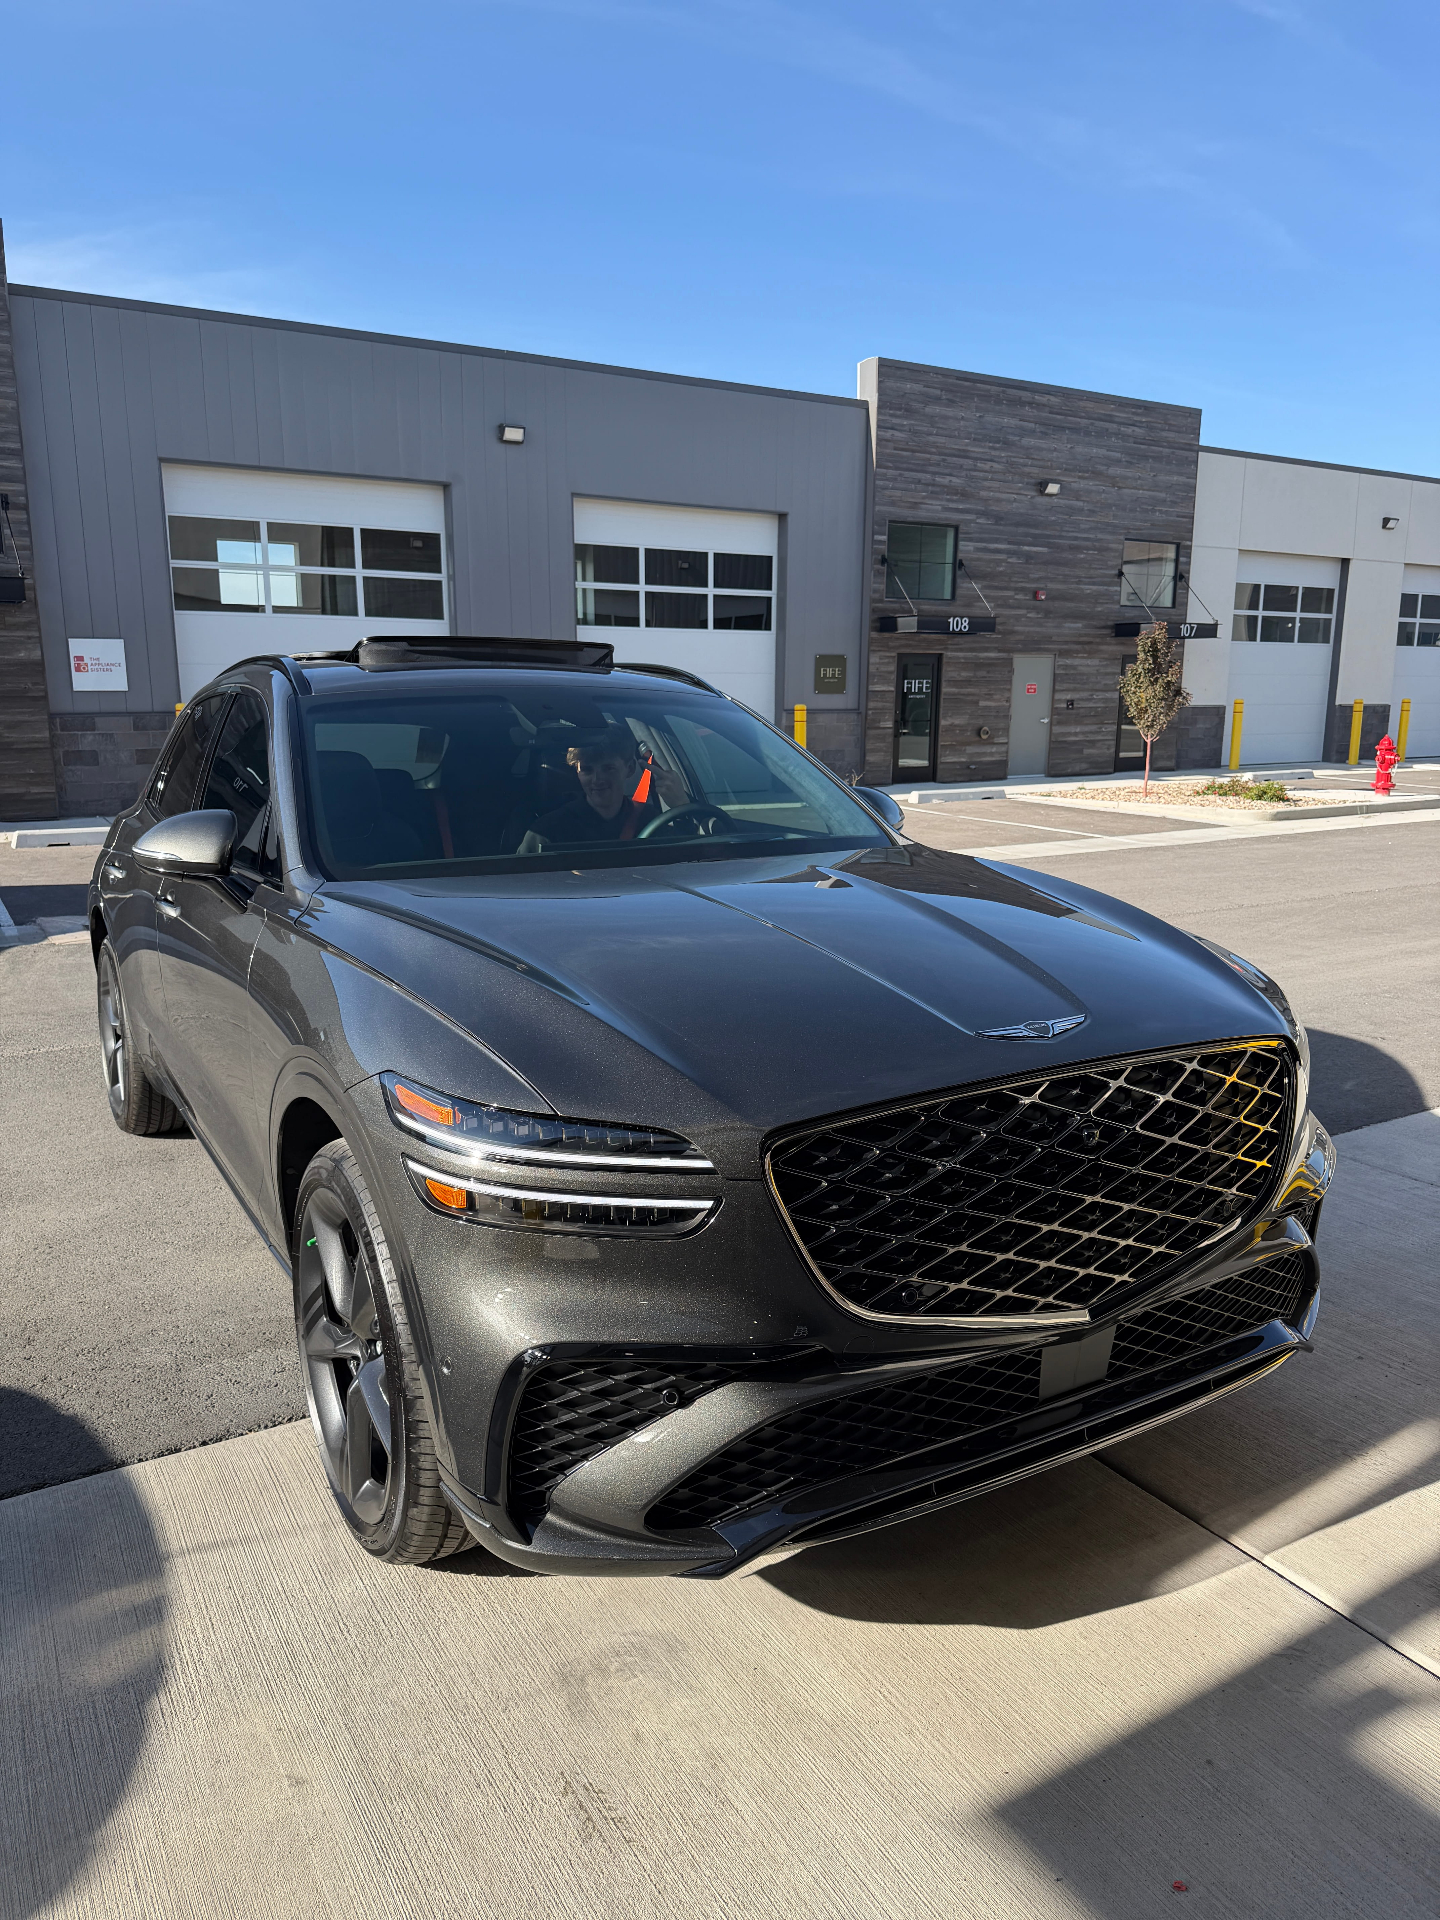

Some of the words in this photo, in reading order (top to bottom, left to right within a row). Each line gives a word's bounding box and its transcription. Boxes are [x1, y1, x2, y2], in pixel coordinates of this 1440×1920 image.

[948, 617, 969, 631] 108
[1180, 624, 1197, 636] 107
[820, 667, 842, 678] FIFE
[903, 679, 931, 693] FIFE
